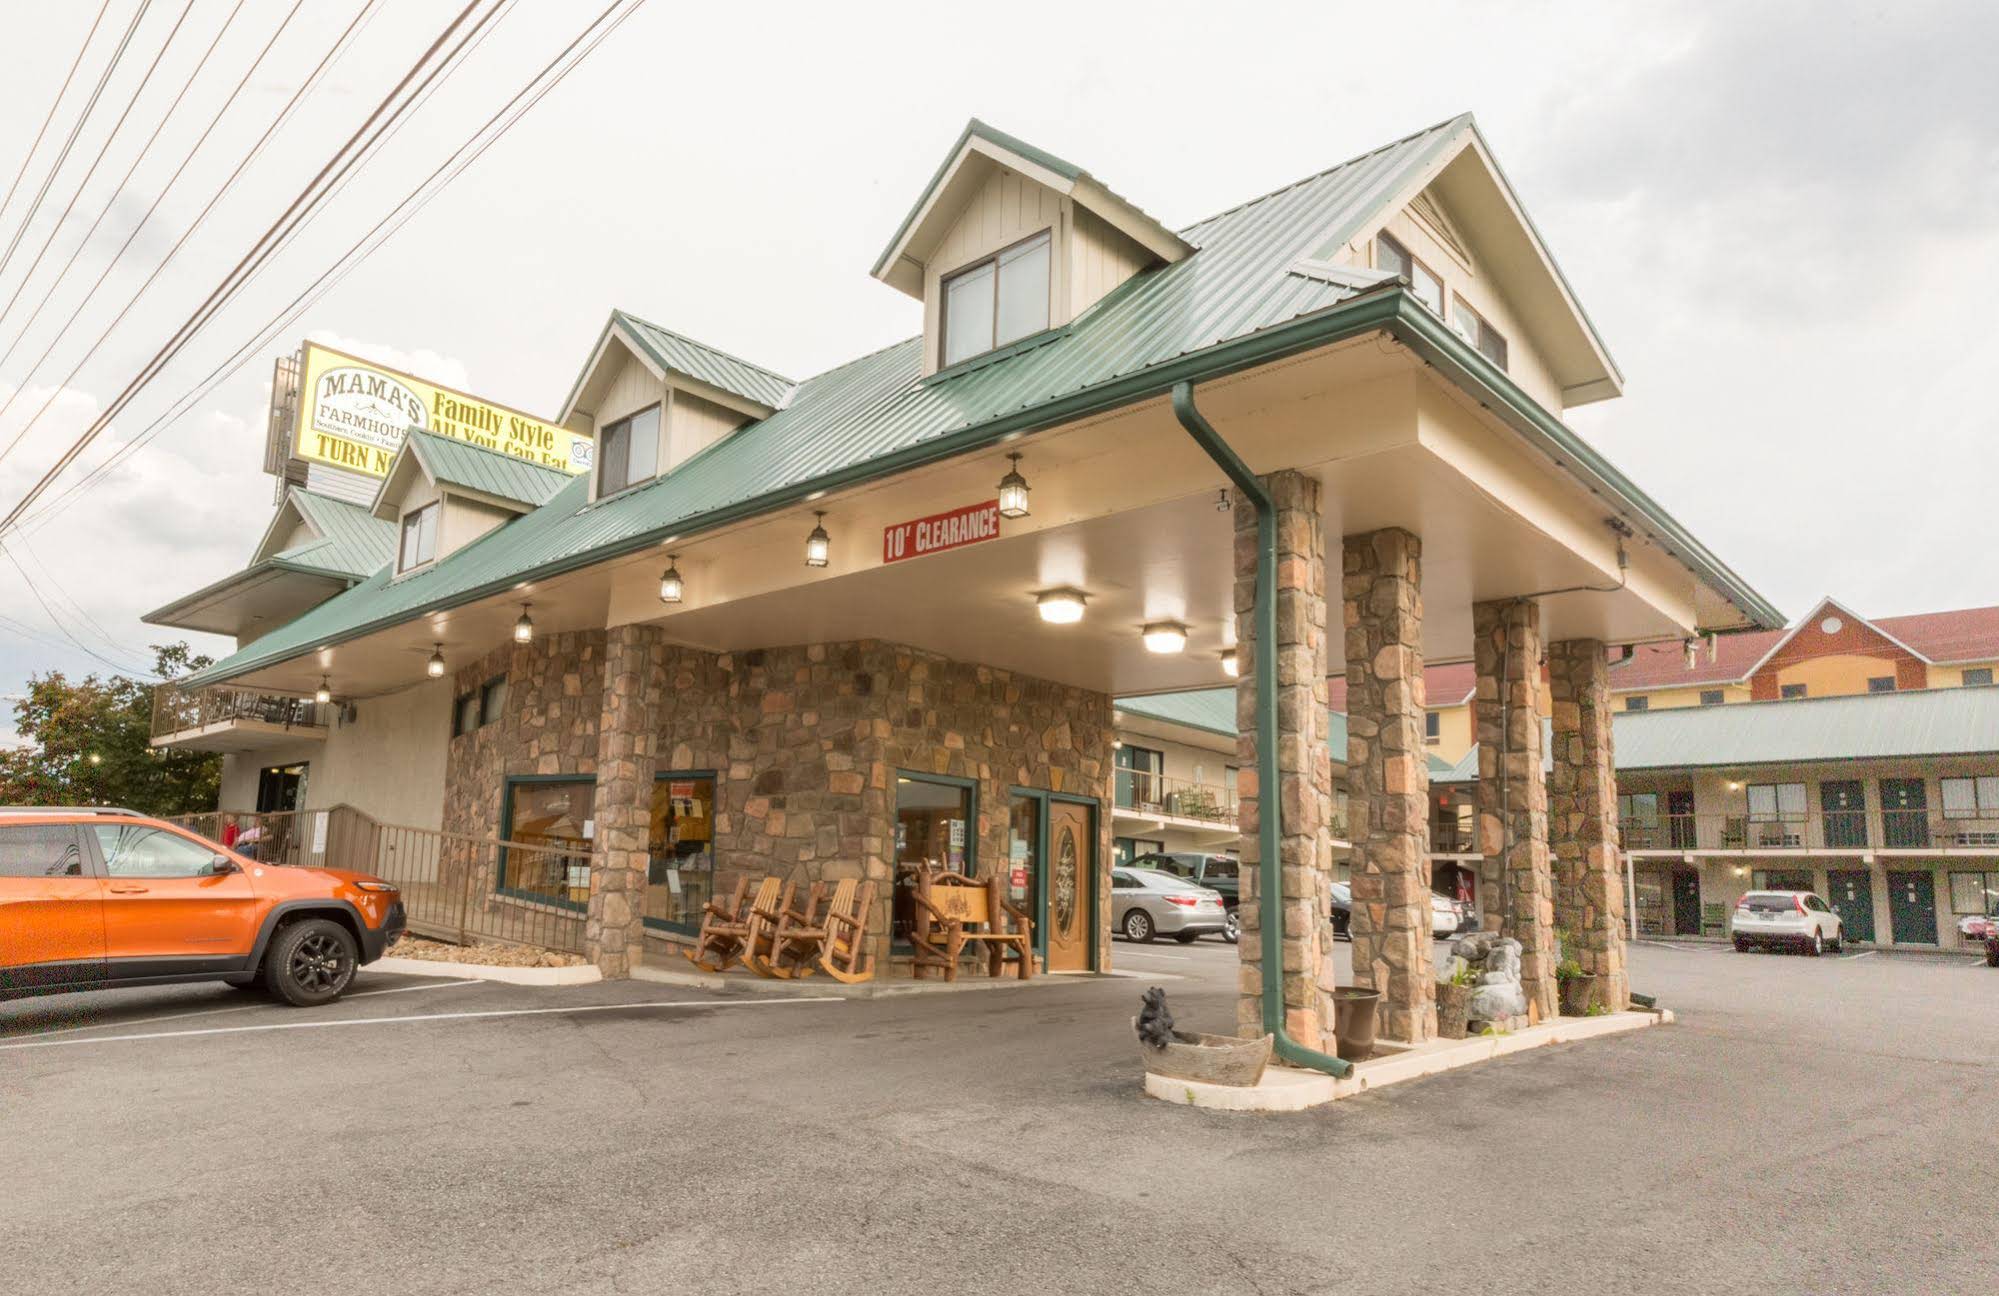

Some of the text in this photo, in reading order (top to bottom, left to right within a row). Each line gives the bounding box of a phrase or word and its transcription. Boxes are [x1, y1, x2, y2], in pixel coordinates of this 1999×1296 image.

[323, 373, 420, 424] MAMA'S
[433, 392, 553, 450] Family Style
[317, 434, 369, 468] TURN
[886, 507, 997, 559] 10' CLEARANCE
